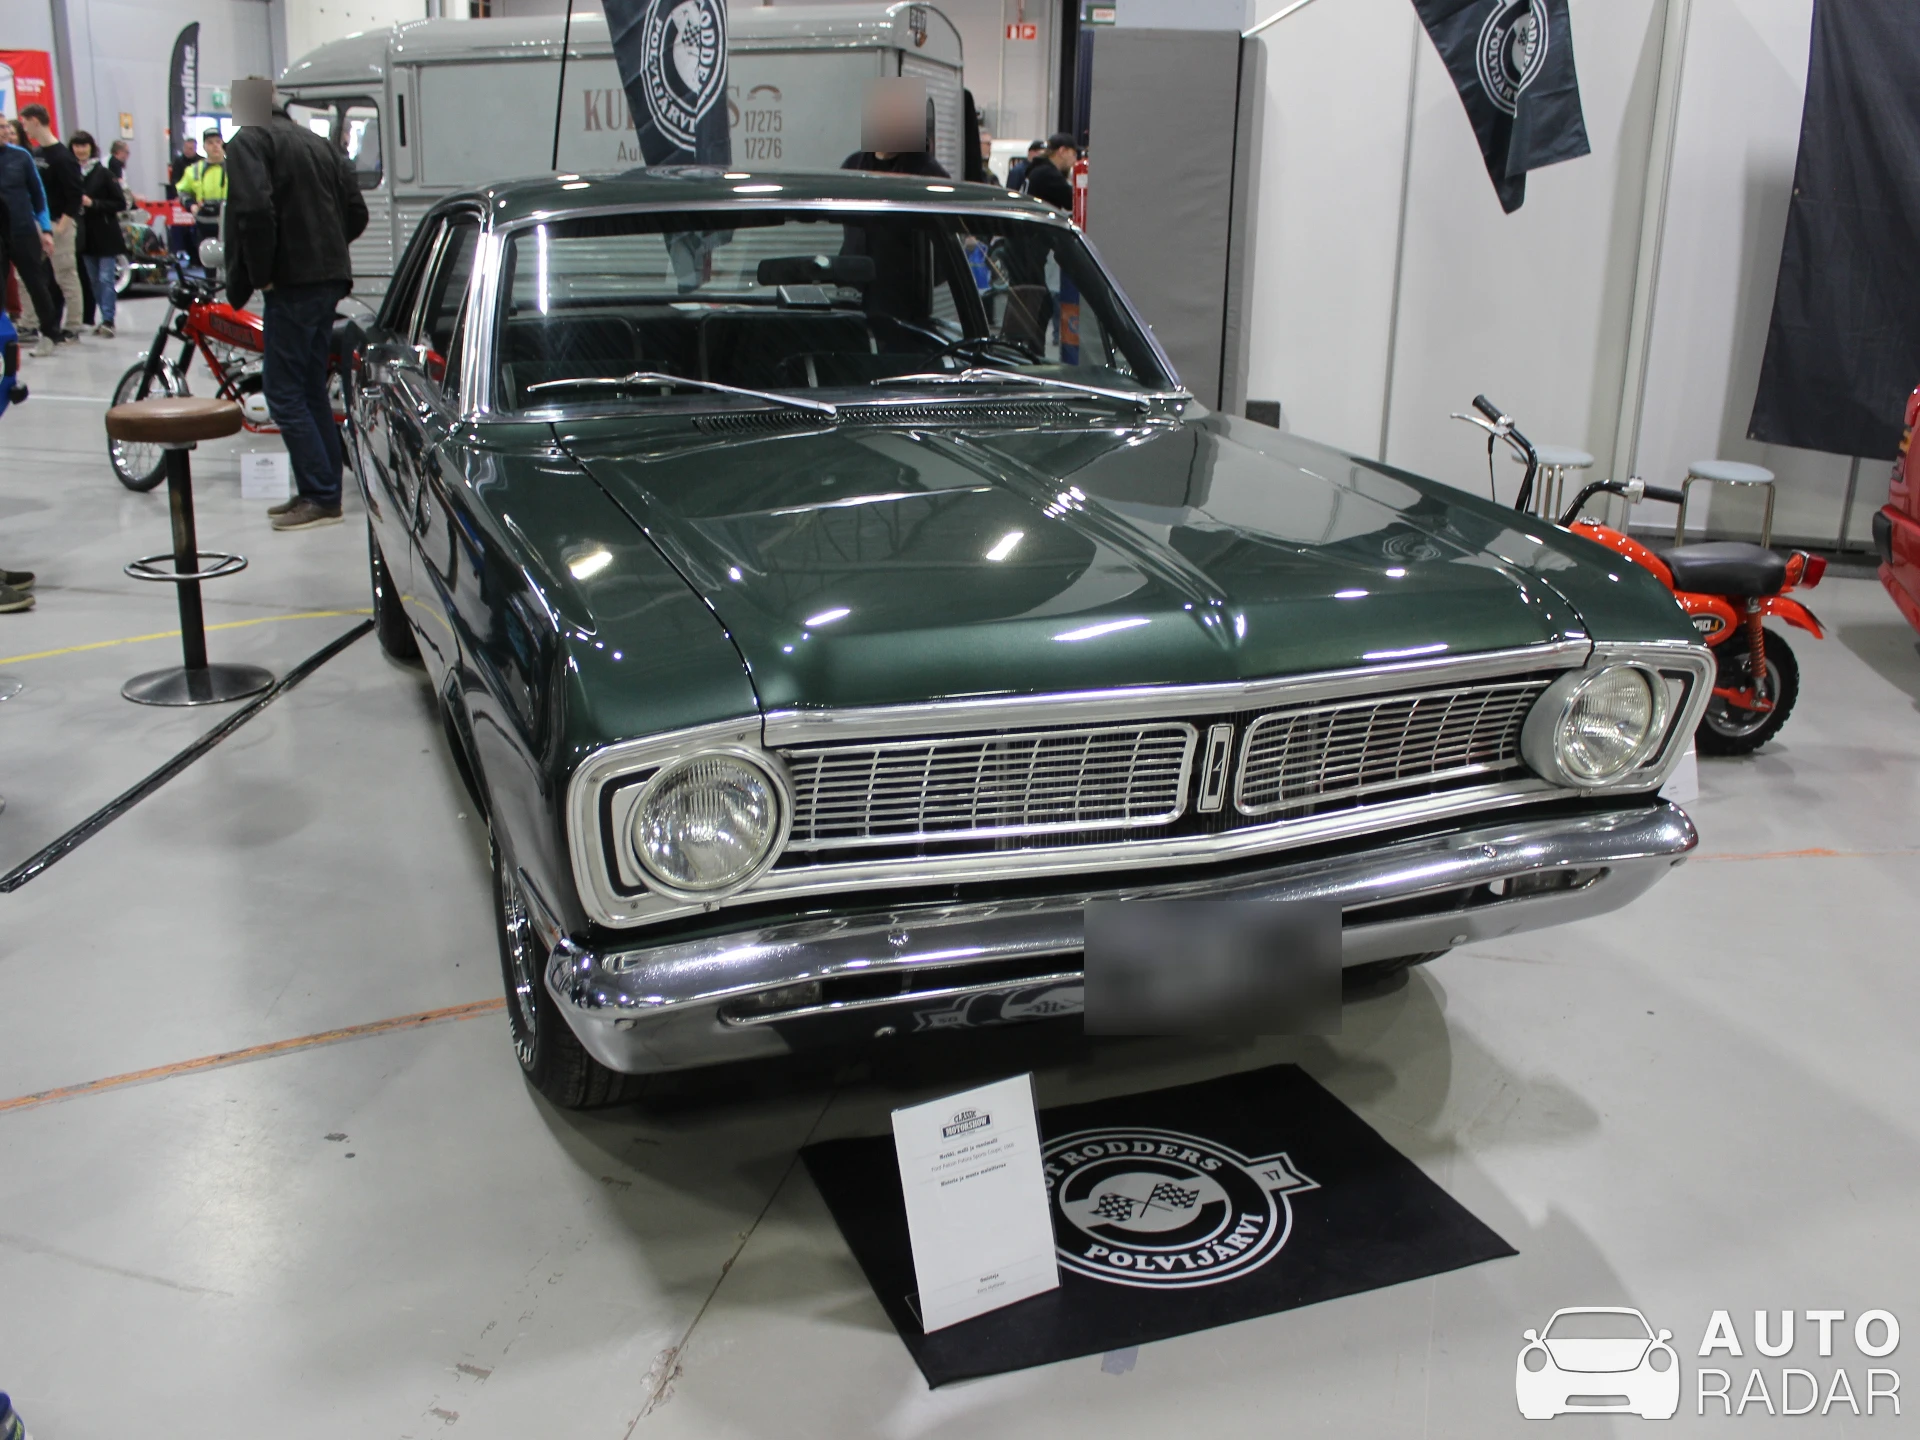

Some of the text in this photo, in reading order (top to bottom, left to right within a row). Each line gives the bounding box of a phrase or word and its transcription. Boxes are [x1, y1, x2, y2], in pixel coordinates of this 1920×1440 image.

[745, 110, 782, 133] 17275
[745, 137, 782, 159] 17276
[945, 1116, 987, 1137] MOTORSHOW
[953, 1110, 977, 1124] CLASSIC
[1059, 1141, 1222, 1172] RODDERS
[1262, 1169, 1281, 1182] 17
[1084, 1212, 1264, 1271] POLVIJÄRVI
